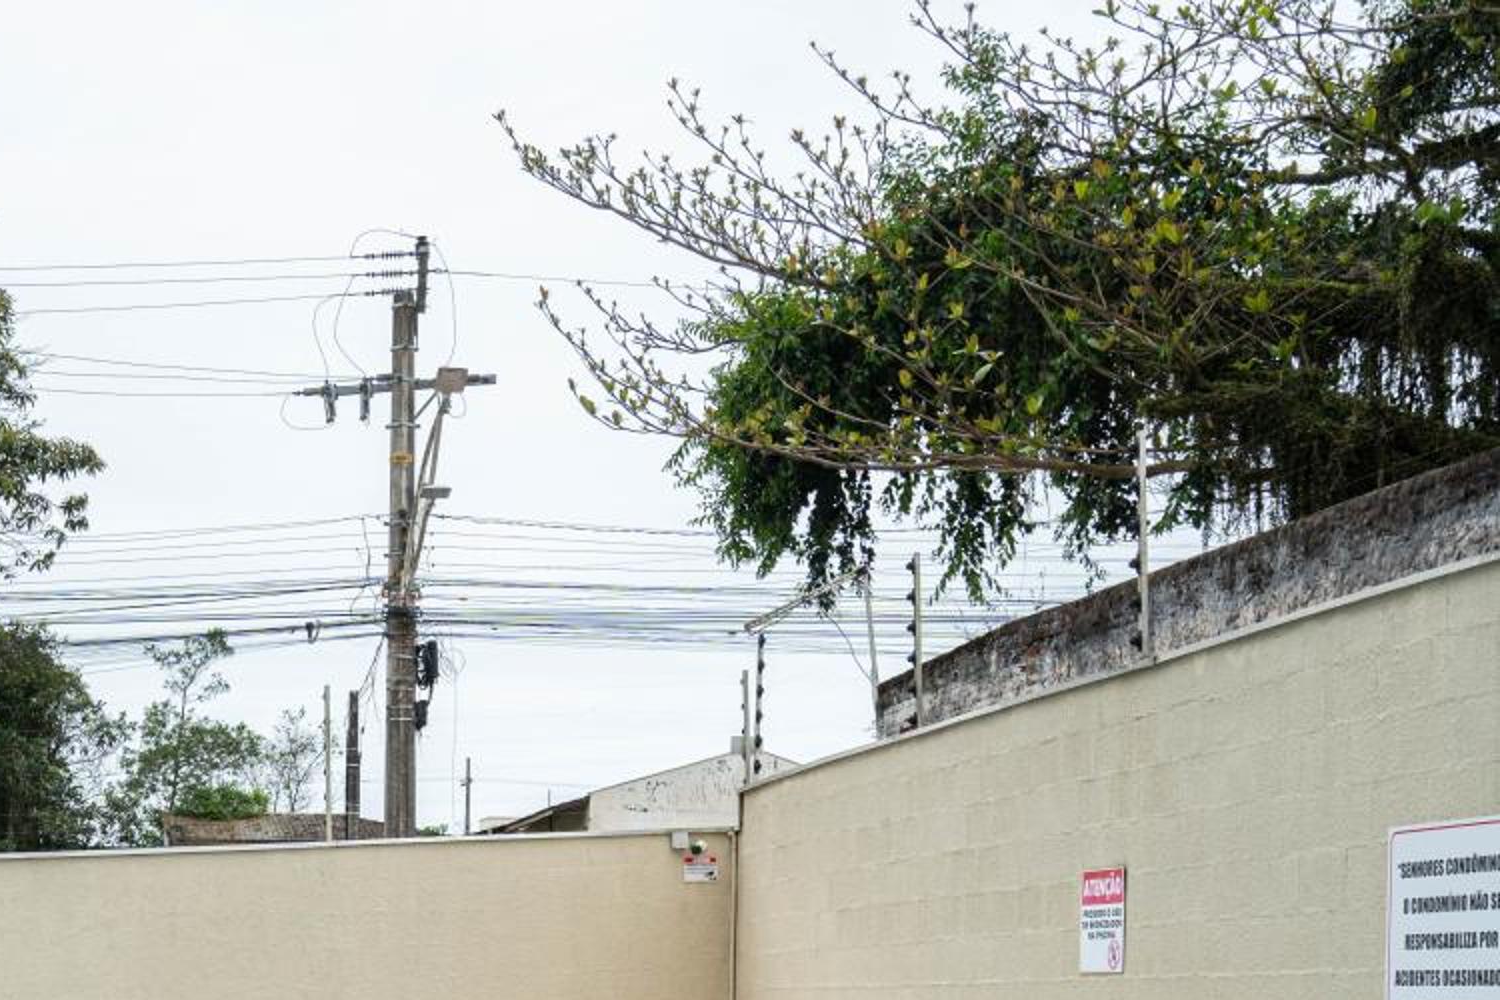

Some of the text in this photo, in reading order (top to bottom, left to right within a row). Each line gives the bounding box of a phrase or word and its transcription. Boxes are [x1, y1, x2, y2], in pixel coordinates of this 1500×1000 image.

[1403, 898, 1409, 914] O
[1411, 893, 1467, 914] CONDOMÍNIO
[1470, 890, 1488, 911] NÃO
[1405, 931, 1499, 950] RESPONSABILIZA POR
[1395, 970, 1440, 986] ACIDENTES
